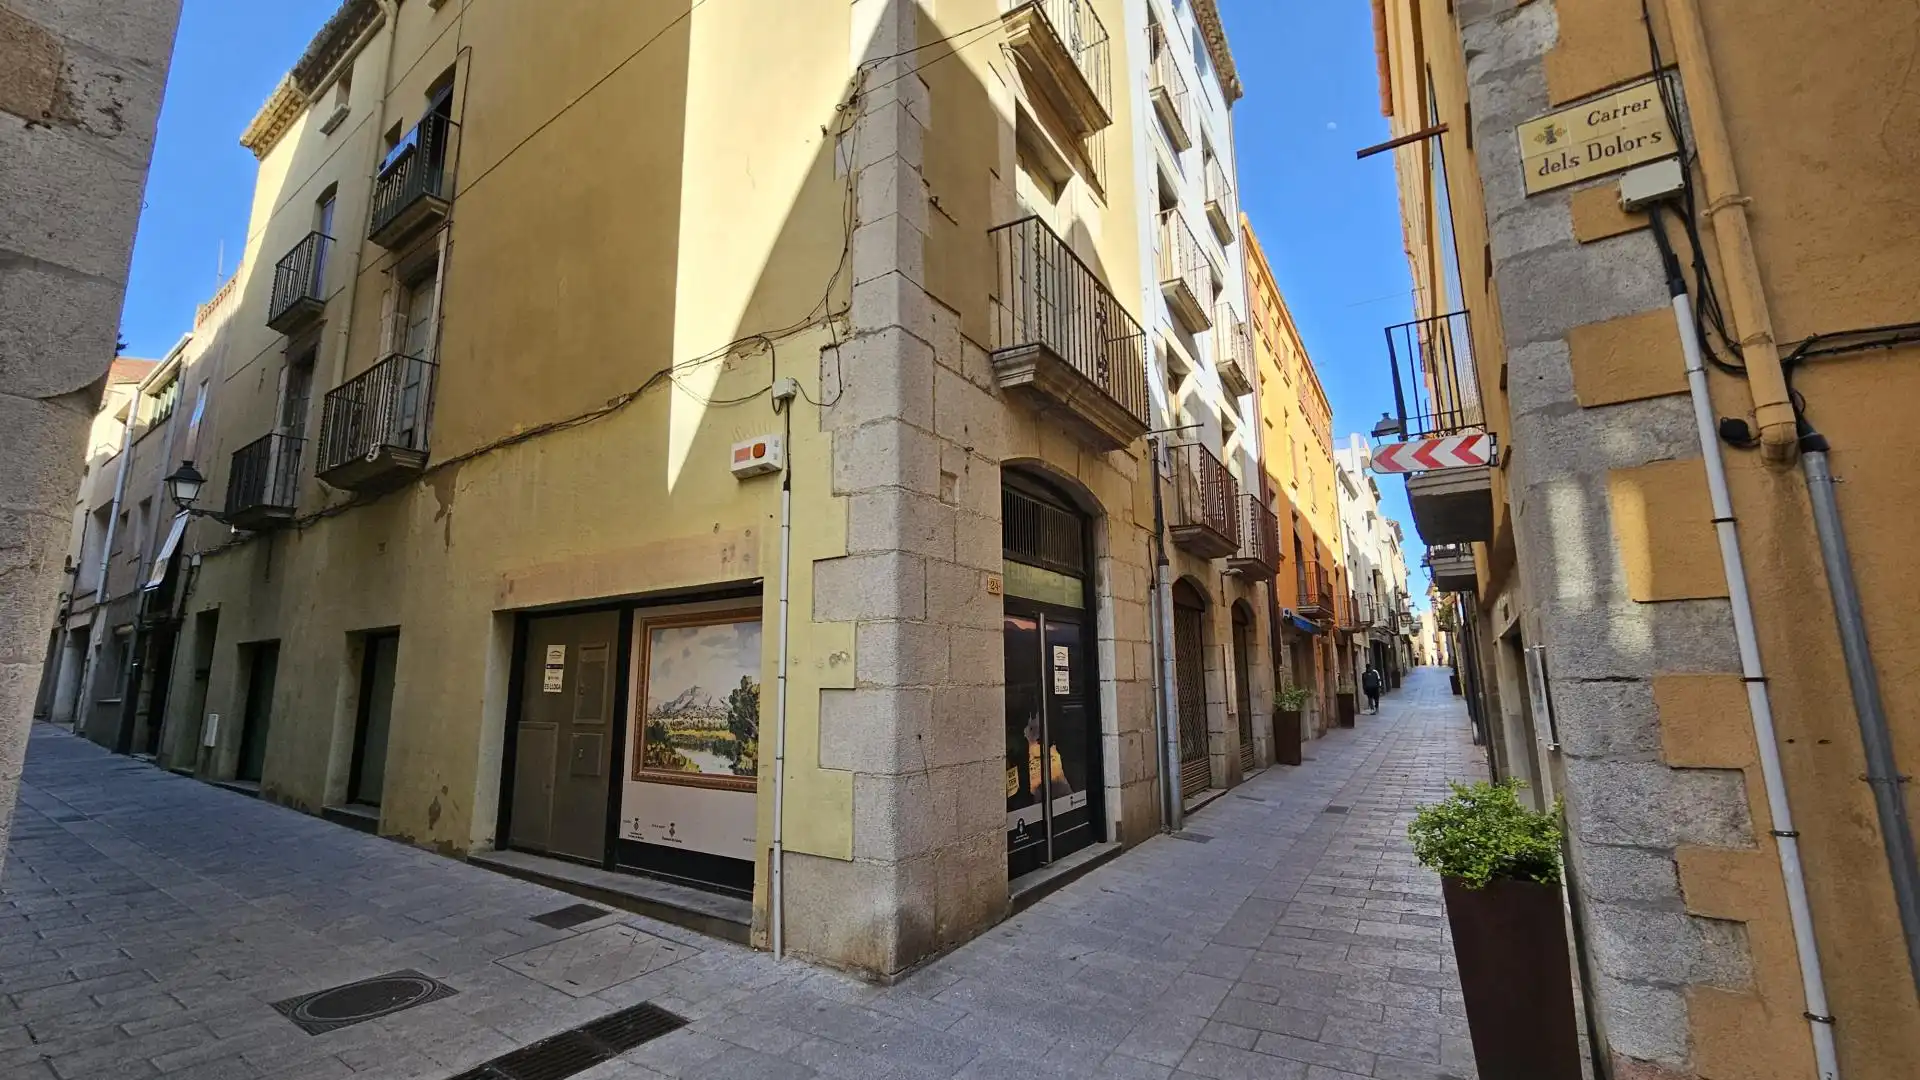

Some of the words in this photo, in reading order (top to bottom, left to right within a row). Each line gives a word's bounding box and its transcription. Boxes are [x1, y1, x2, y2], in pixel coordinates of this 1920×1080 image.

[1586, 97, 1652, 127] Carrer
[1538, 152, 1580, 177] dels
[1586, 130, 1662, 162] Dolors
